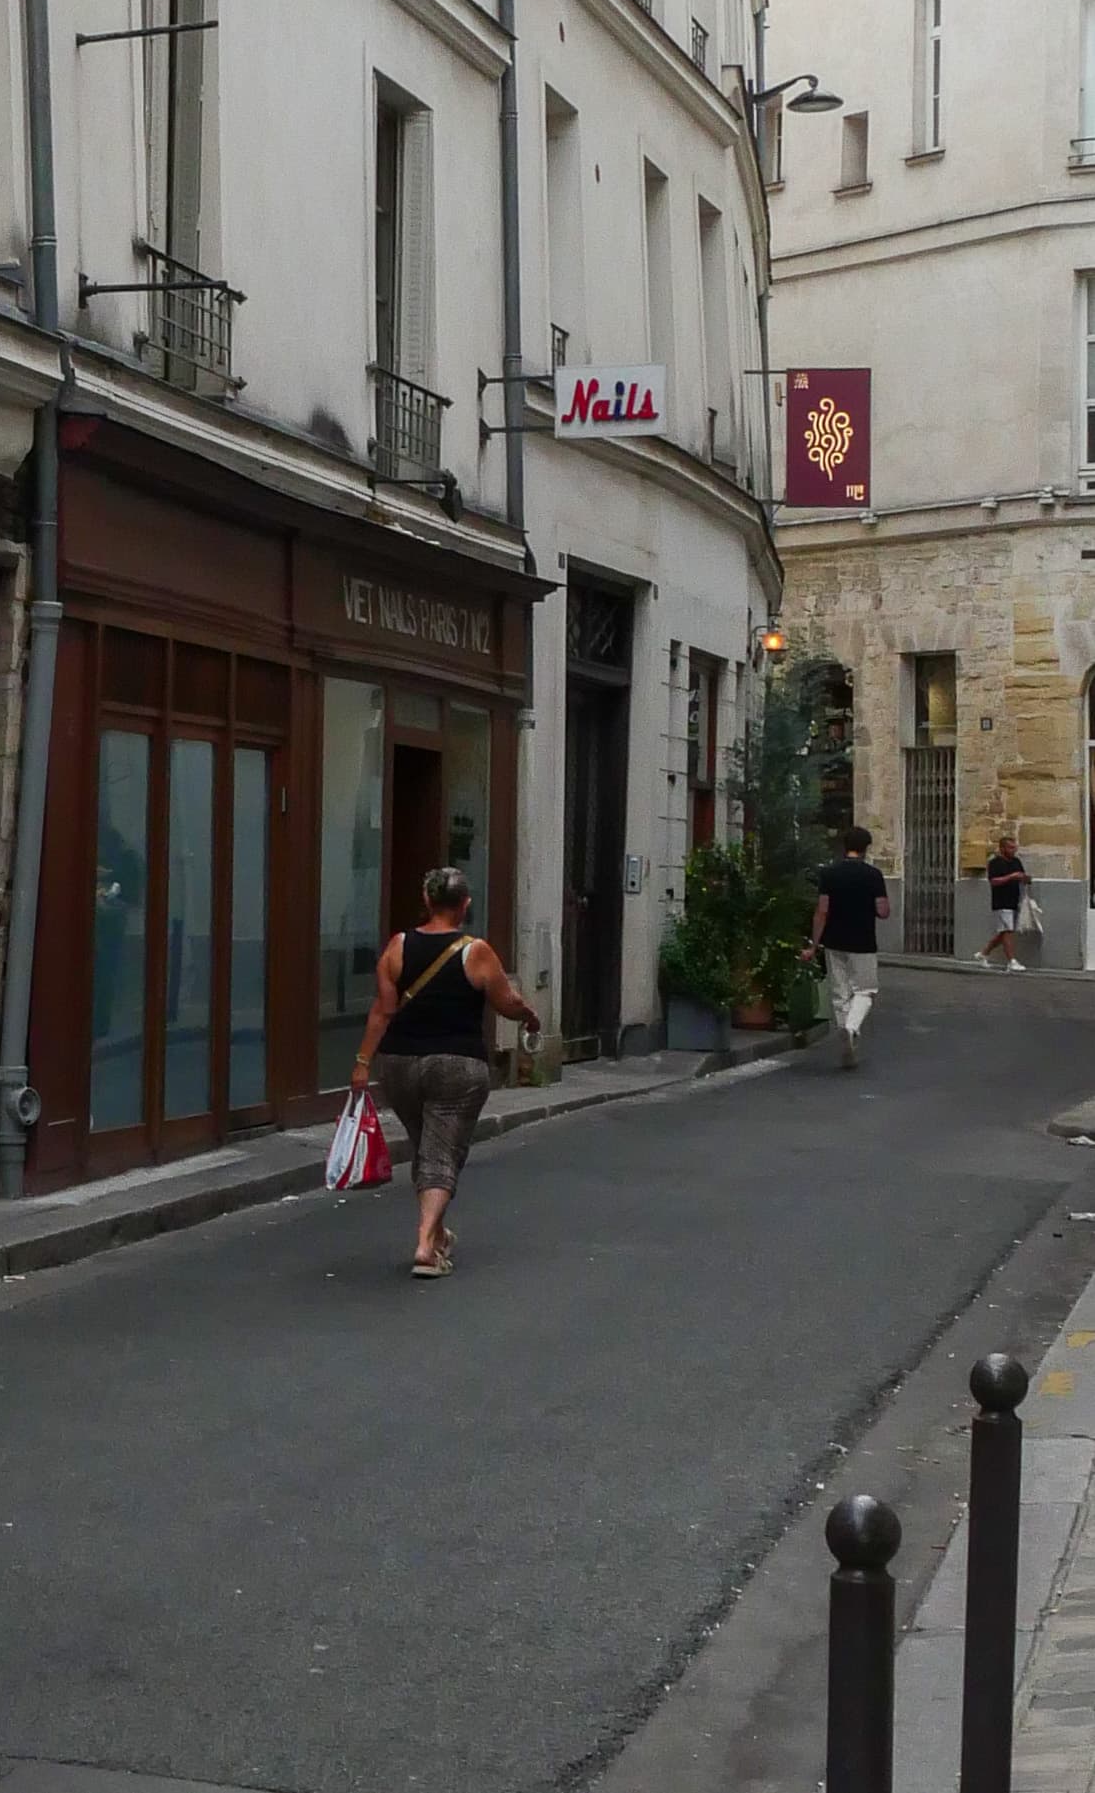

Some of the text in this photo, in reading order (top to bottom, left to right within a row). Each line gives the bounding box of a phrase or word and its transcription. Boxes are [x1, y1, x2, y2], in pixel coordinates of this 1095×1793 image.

[561, 377, 660, 425] Nails
[379, 585, 418, 637] NAILS
[420, 599, 458, 647] PARIS
